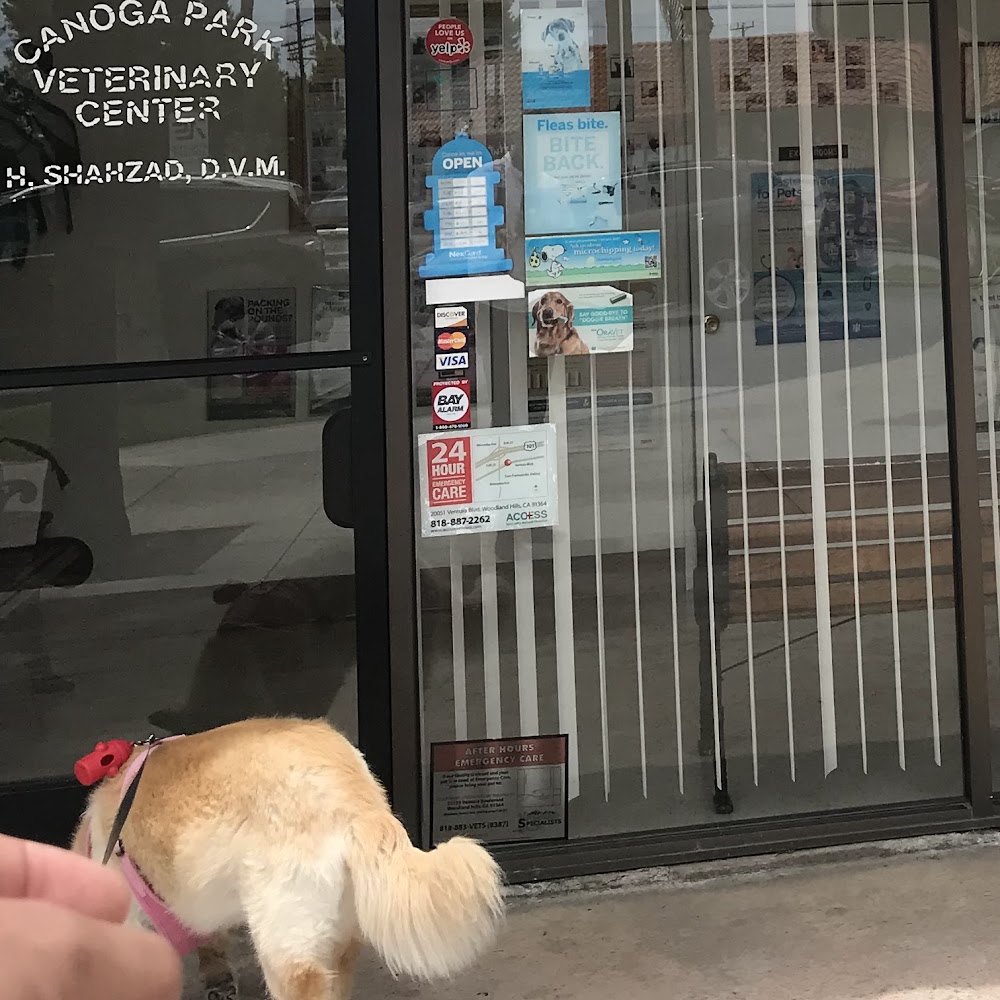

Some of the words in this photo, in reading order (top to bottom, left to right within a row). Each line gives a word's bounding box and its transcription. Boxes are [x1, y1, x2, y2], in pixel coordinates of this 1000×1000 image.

[14, 0, 171, 65] CANOGA
[184, 1, 284, 60] PARK
[431, 42, 458, 56] yelp
[32, 61, 261, 95] VETERINARY
[75, 96, 221, 128] CENTER
[537, 119, 574, 131] Fleas
[578, 118, 608, 129] bite.
[550, 136, 596, 152] BITE
[442, 157, 483, 169] OPEN
[543, 154, 604, 172] BACK.
[6, 167, 33, 188] H.
[43, 160, 192, 187] SHAHZAD,
[201, 155, 286, 180] D.V.M.
[573, 245, 632, 255] microchipping
[633, 244, 655, 253] today!
[247, 299, 290, 308] PACKING
[247, 307, 264, 315] ON
[440, 355, 466, 366] VISA
[438, 394, 464, 405] BAY
[431, 440, 467, 464] 24
[432, 463, 465, 476] HOUR
[433, 479, 466, 487] EMERGENCY
[432, 486, 467, 500] CARE
[430, 515, 491, 527] 818-887-2262
[465, 746, 496, 755] AFTER
[499, 744, 535, 753] HOURS
[455, 756, 516, 767] EMERGENCY
[520, 754, 545, 762] CARE
